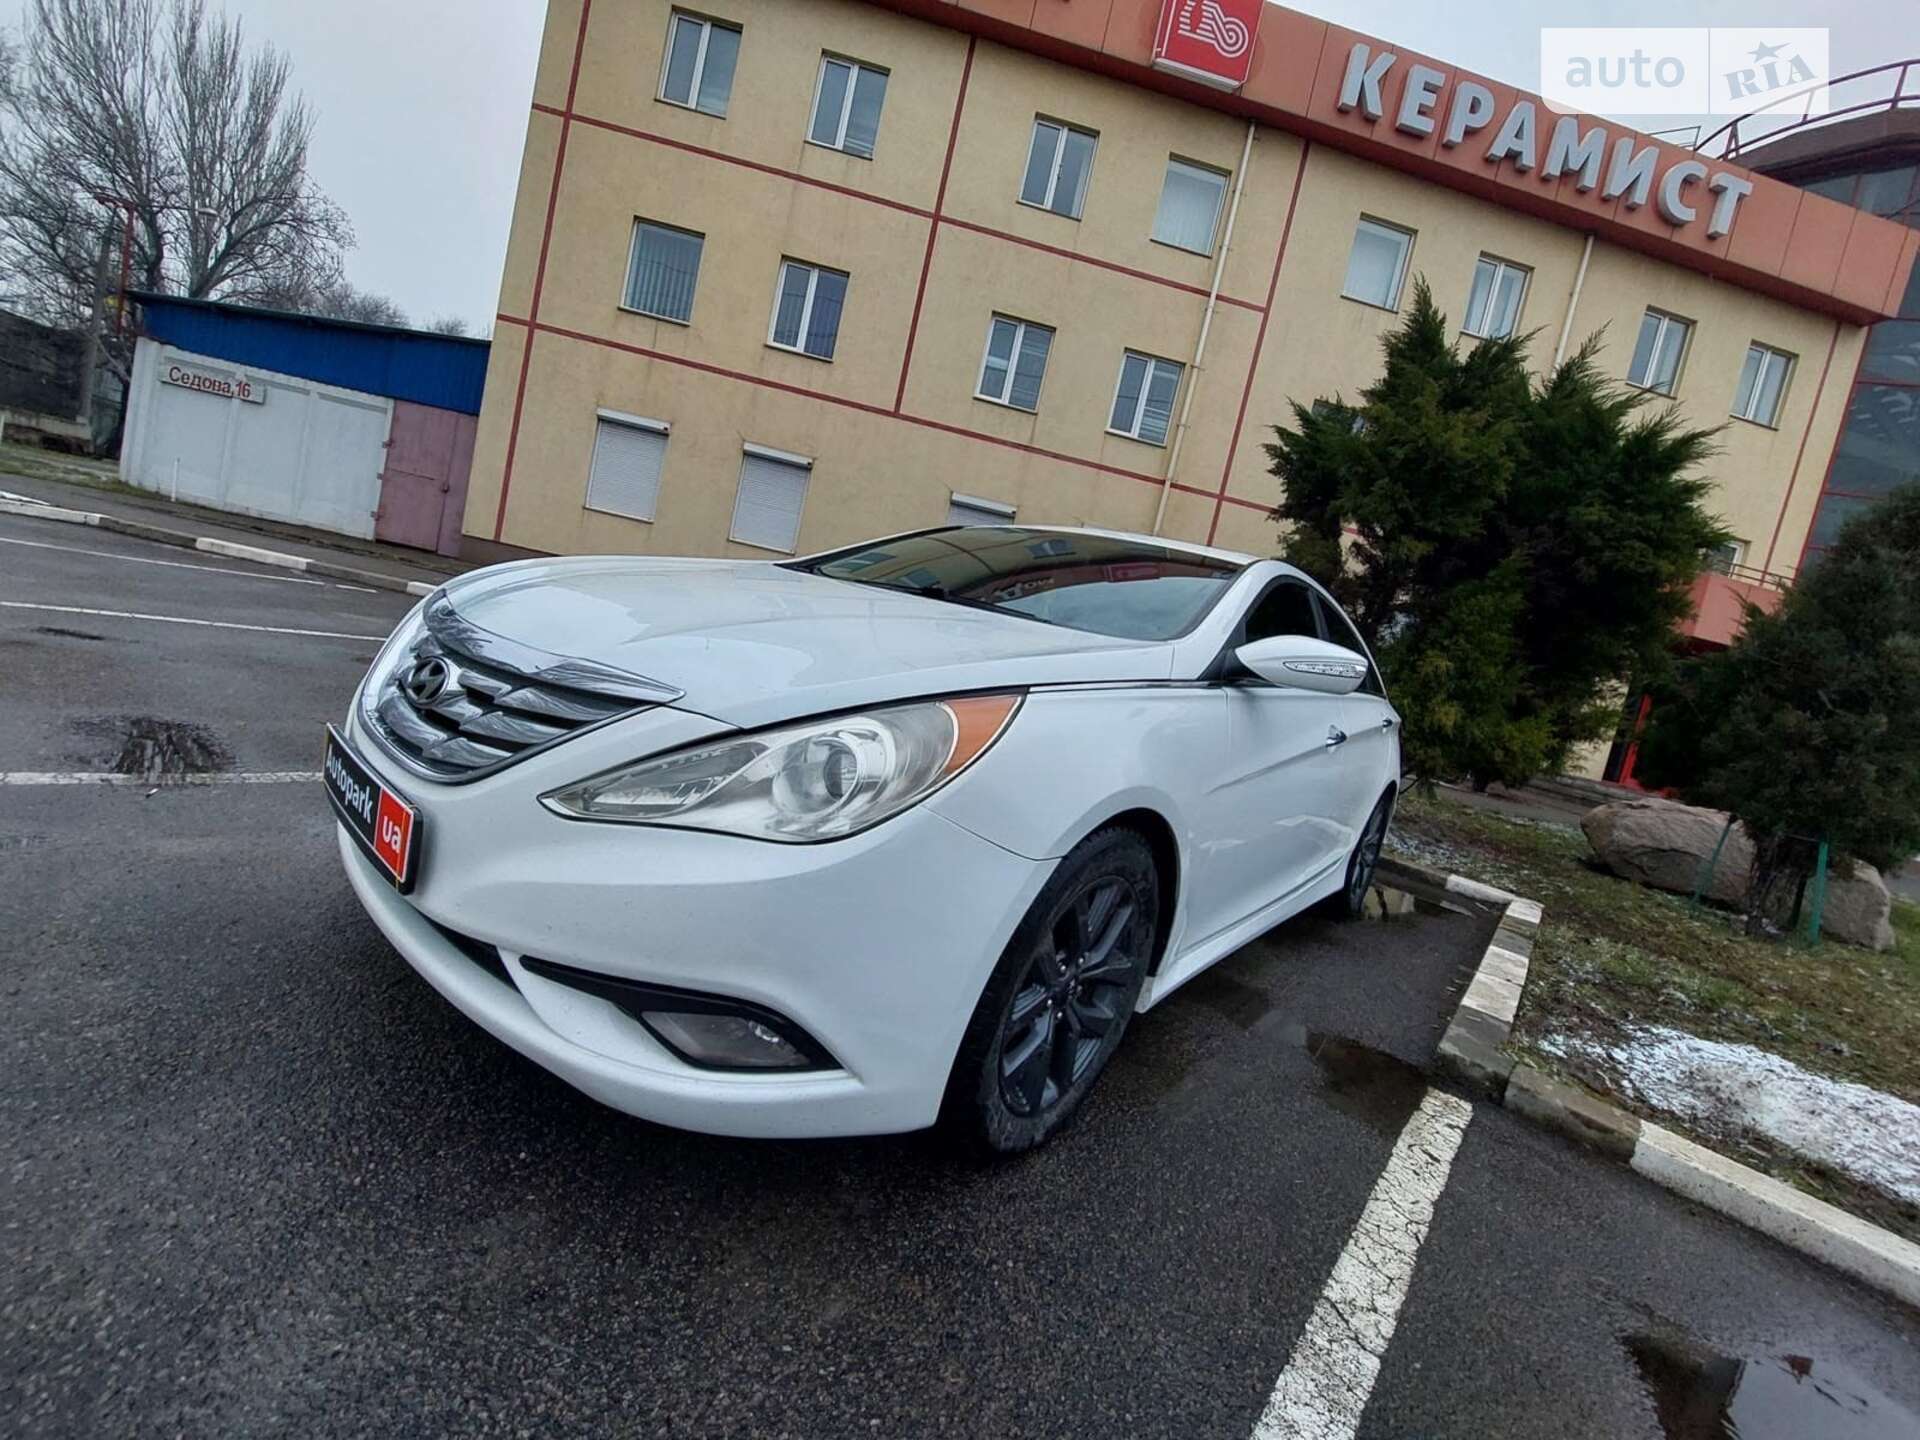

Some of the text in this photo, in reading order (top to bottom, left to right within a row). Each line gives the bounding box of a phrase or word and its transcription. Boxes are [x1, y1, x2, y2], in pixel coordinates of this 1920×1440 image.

[1337, 43, 1753, 239] КЕРАМИСТ
[326, 744, 401, 853] Autopark ua
